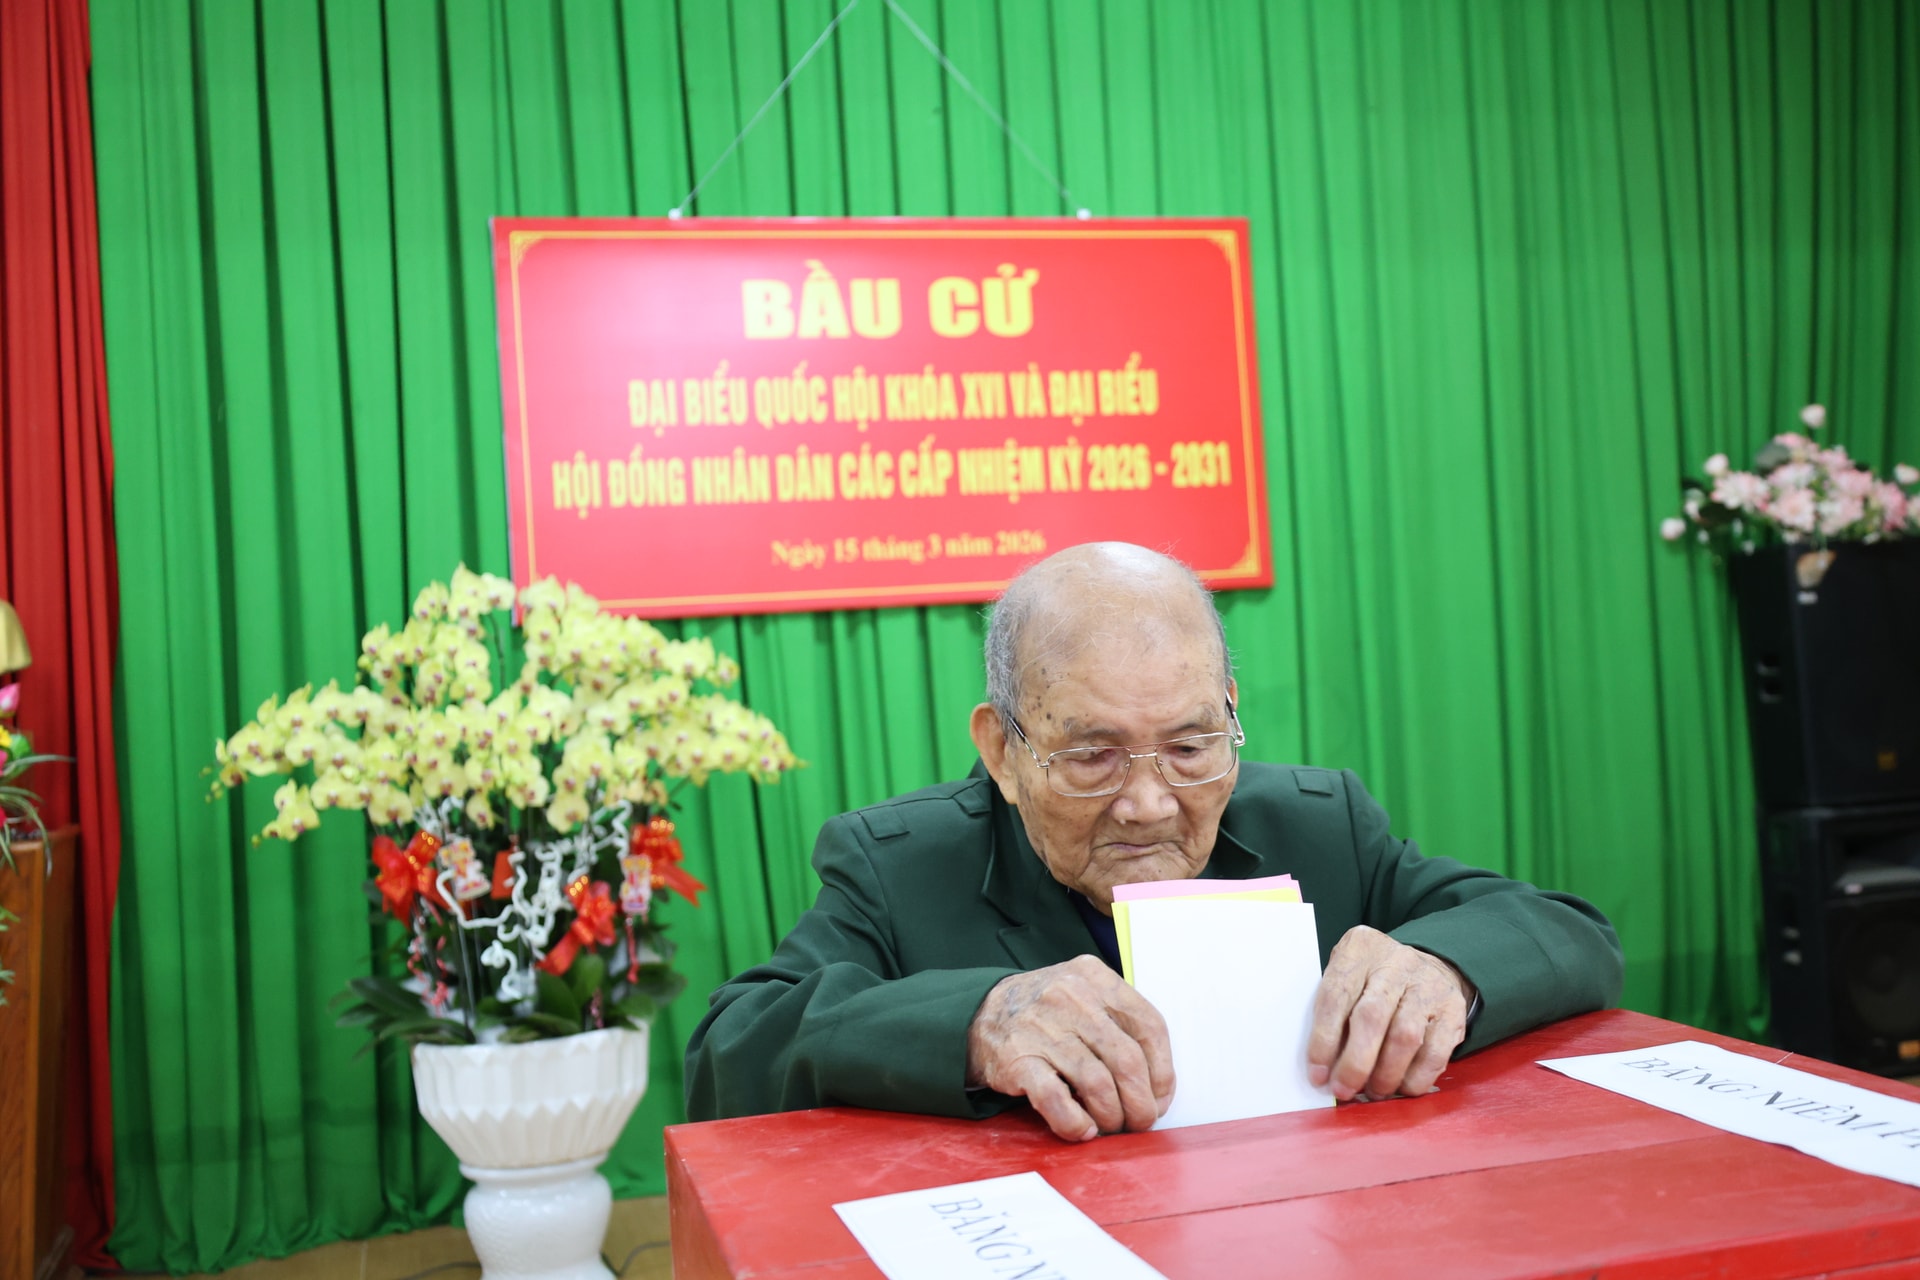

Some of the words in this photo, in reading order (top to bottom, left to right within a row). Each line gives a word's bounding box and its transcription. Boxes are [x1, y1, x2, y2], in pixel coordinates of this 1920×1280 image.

[741, 259, 902, 339] BẦU
[928, 262, 1040, 338] CỬ
[628, 379, 678, 437] ĐẠI
[683, 359, 749, 426] BIỂU
[754, 360, 828, 430] QUỐC
[832, 365, 881, 432] HỘI
[884, 363, 960, 420] KHÓA
[961, 371, 1007, 419] XVI
[1009, 361, 1047, 418] VÀ
[1048, 369, 1096, 426] ĐẠI
[1098, 351, 1160, 416] BIỂU
[552, 450, 602, 519] HỘI
[692, 446, 772, 504] NHÂN
[775, 444, 835, 502] DÂN
[838, 441, 895, 500] CÁC
[899, 433, 953, 498] CẤP
[958, 437, 1046, 504] NHIỆM
[1048, 436, 1083, 492] KỲ
[1088, 443, 1151, 491] 2026
[1171, 440, 1233, 488] 2031
[771, 539, 827, 570] Ngày
[833, 536, 859, 563] 15
[862, 534, 926, 565] tháng
[927, 532, 943, 560] 3
[945, 531, 994, 558] năm
[996, 528, 1048, 556] 2026
